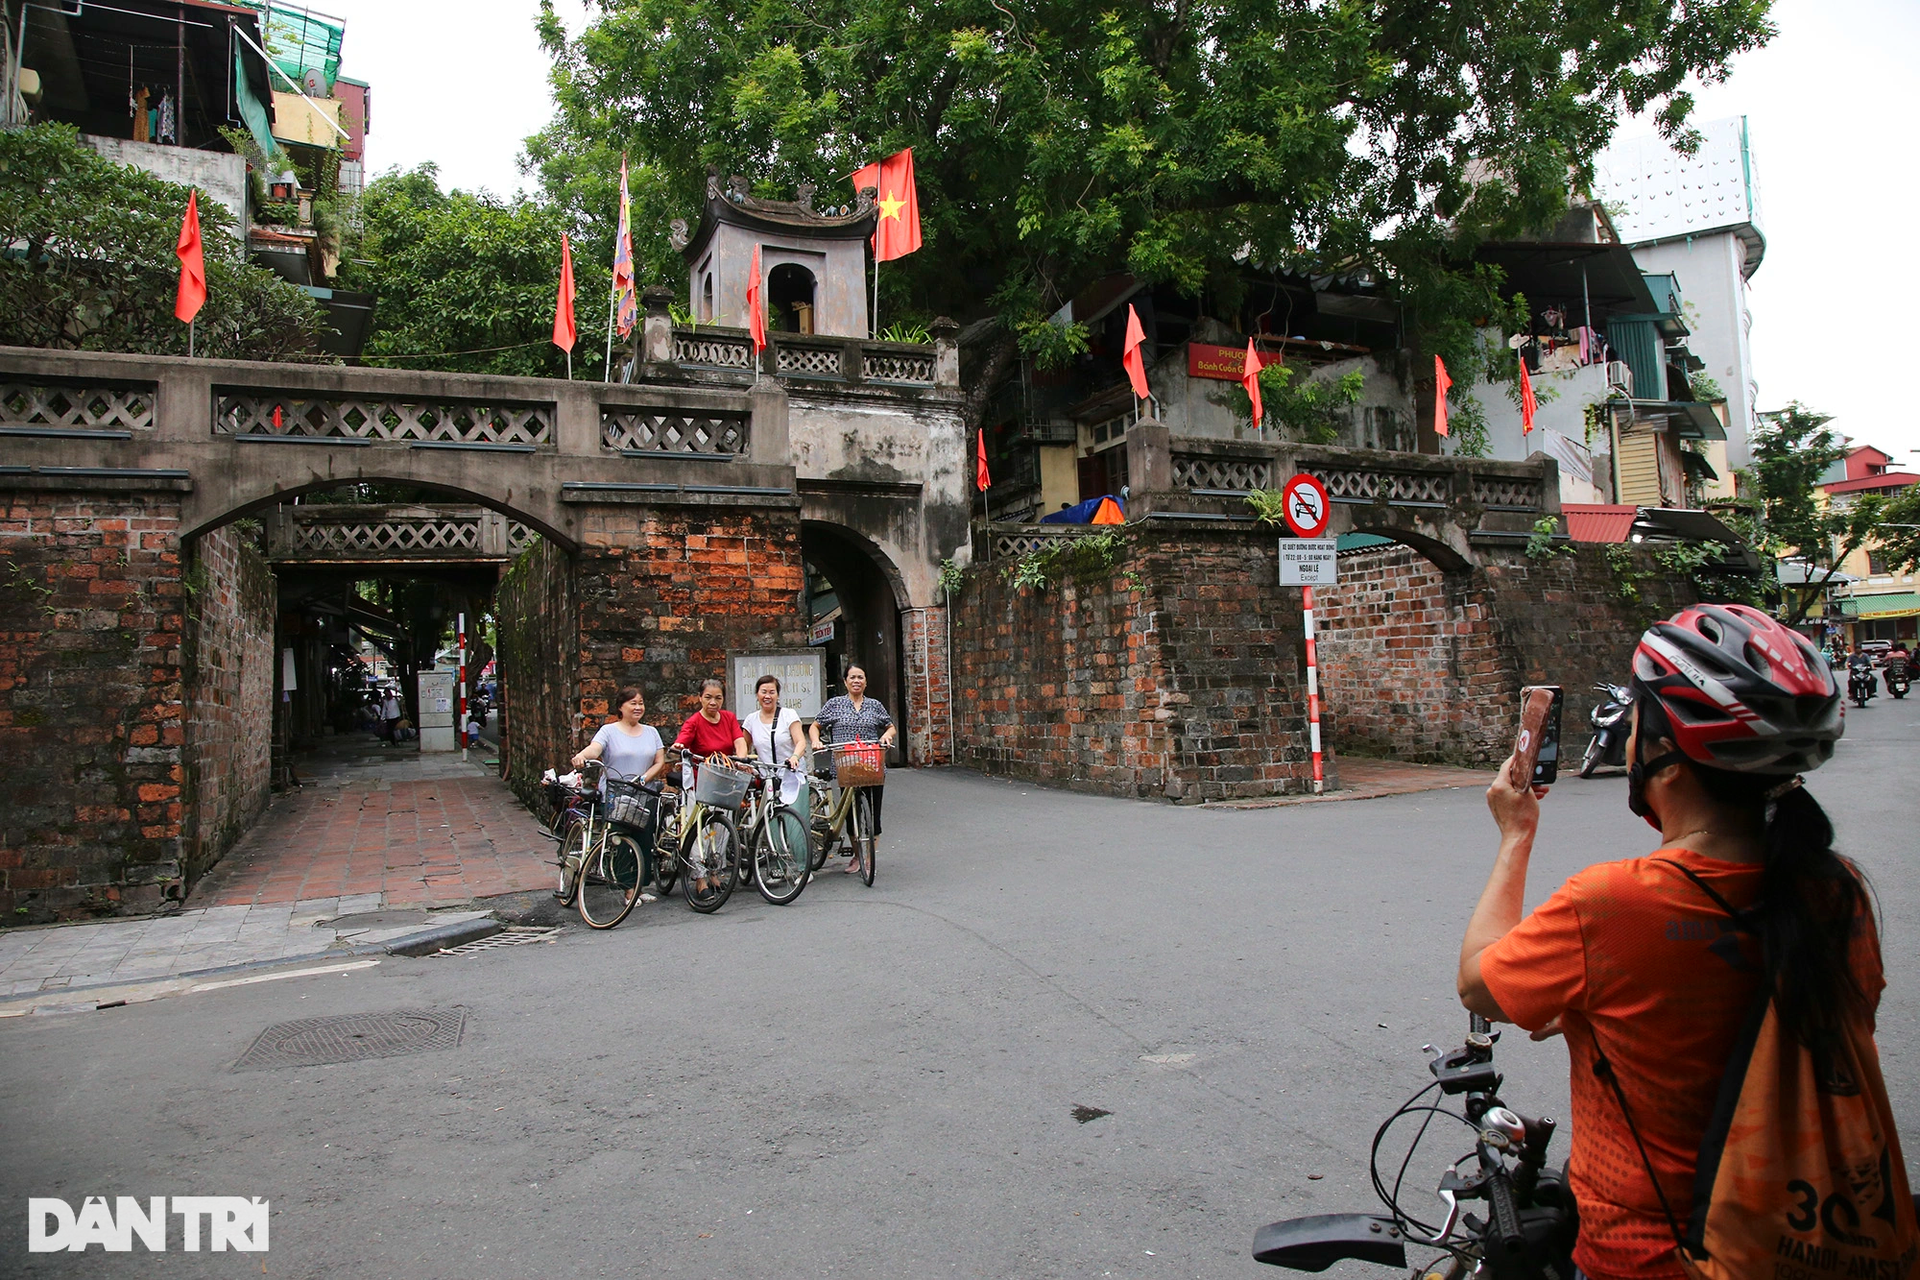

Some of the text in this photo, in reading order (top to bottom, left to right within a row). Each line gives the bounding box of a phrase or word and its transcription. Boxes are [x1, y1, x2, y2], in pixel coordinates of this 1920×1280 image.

[1197, 360, 1218, 372] Bánh
[1300, 573, 1319, 582] Except
[1785, 1178, 1861, 1245] 30
